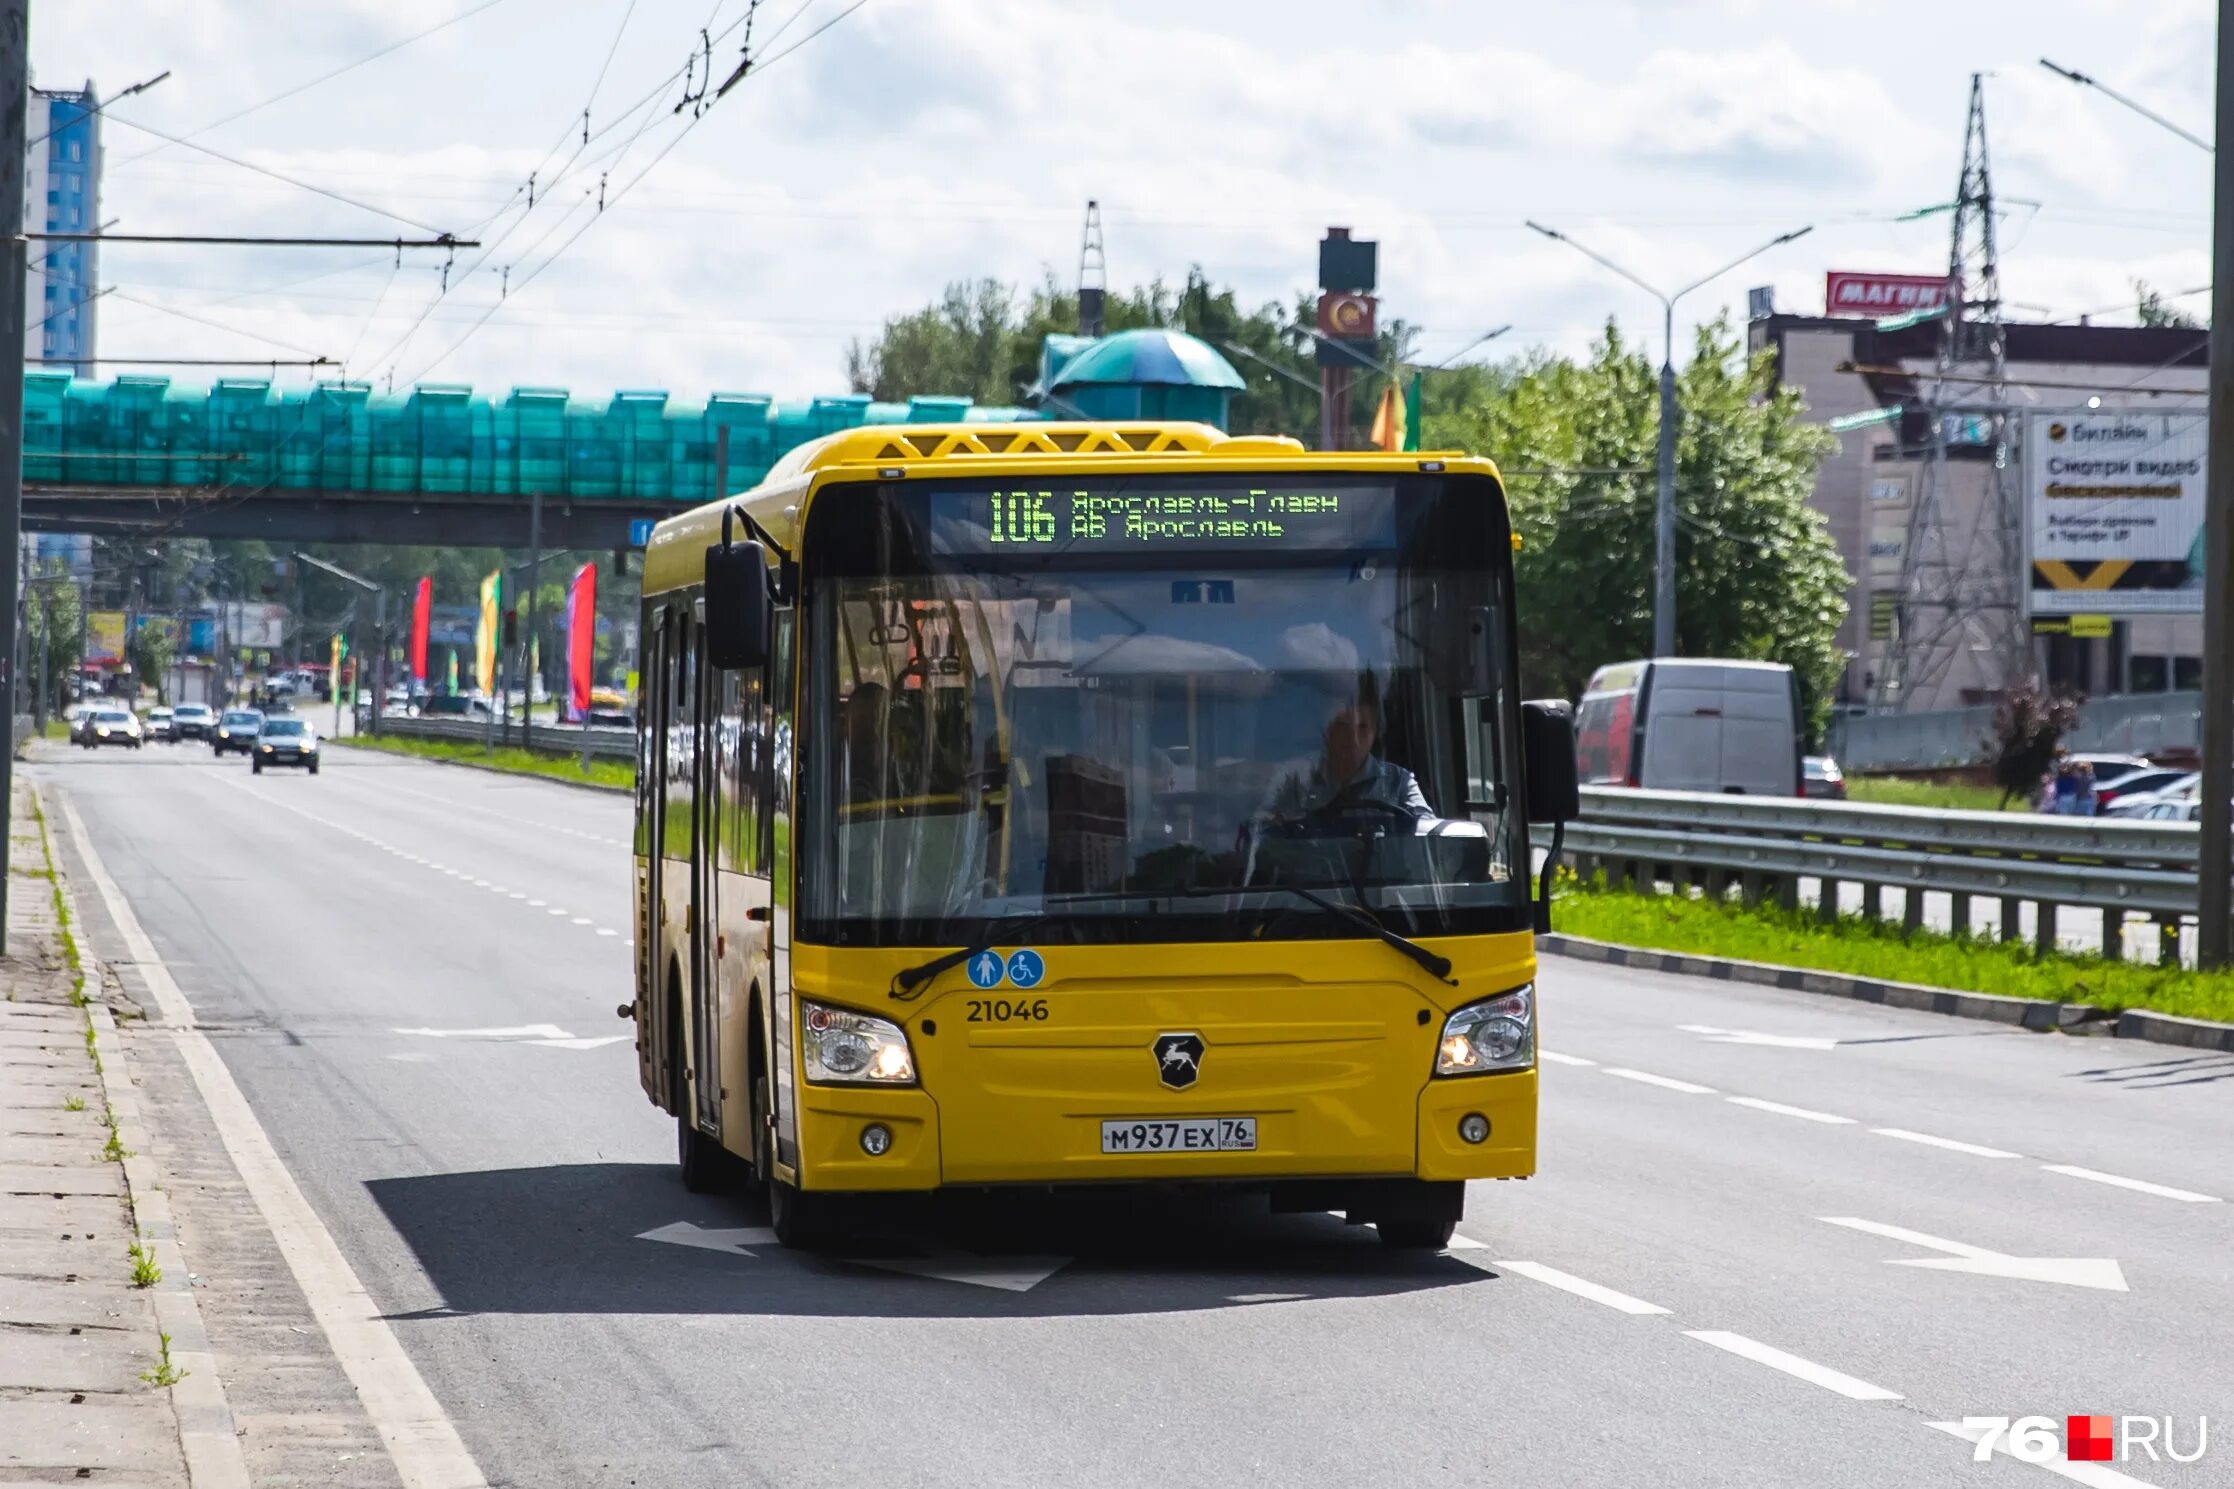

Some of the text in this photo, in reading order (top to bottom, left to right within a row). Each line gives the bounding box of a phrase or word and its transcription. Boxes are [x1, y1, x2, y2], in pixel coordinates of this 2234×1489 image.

[2048, 458, 2130, 479] Смотри
[990, 491, 1055, 542] 106
[1126, 514, 1285, 541] Ярославль
[966, 1000, 1049, 1022] 21046
[1222, 1121, 1248, 1140] 76
